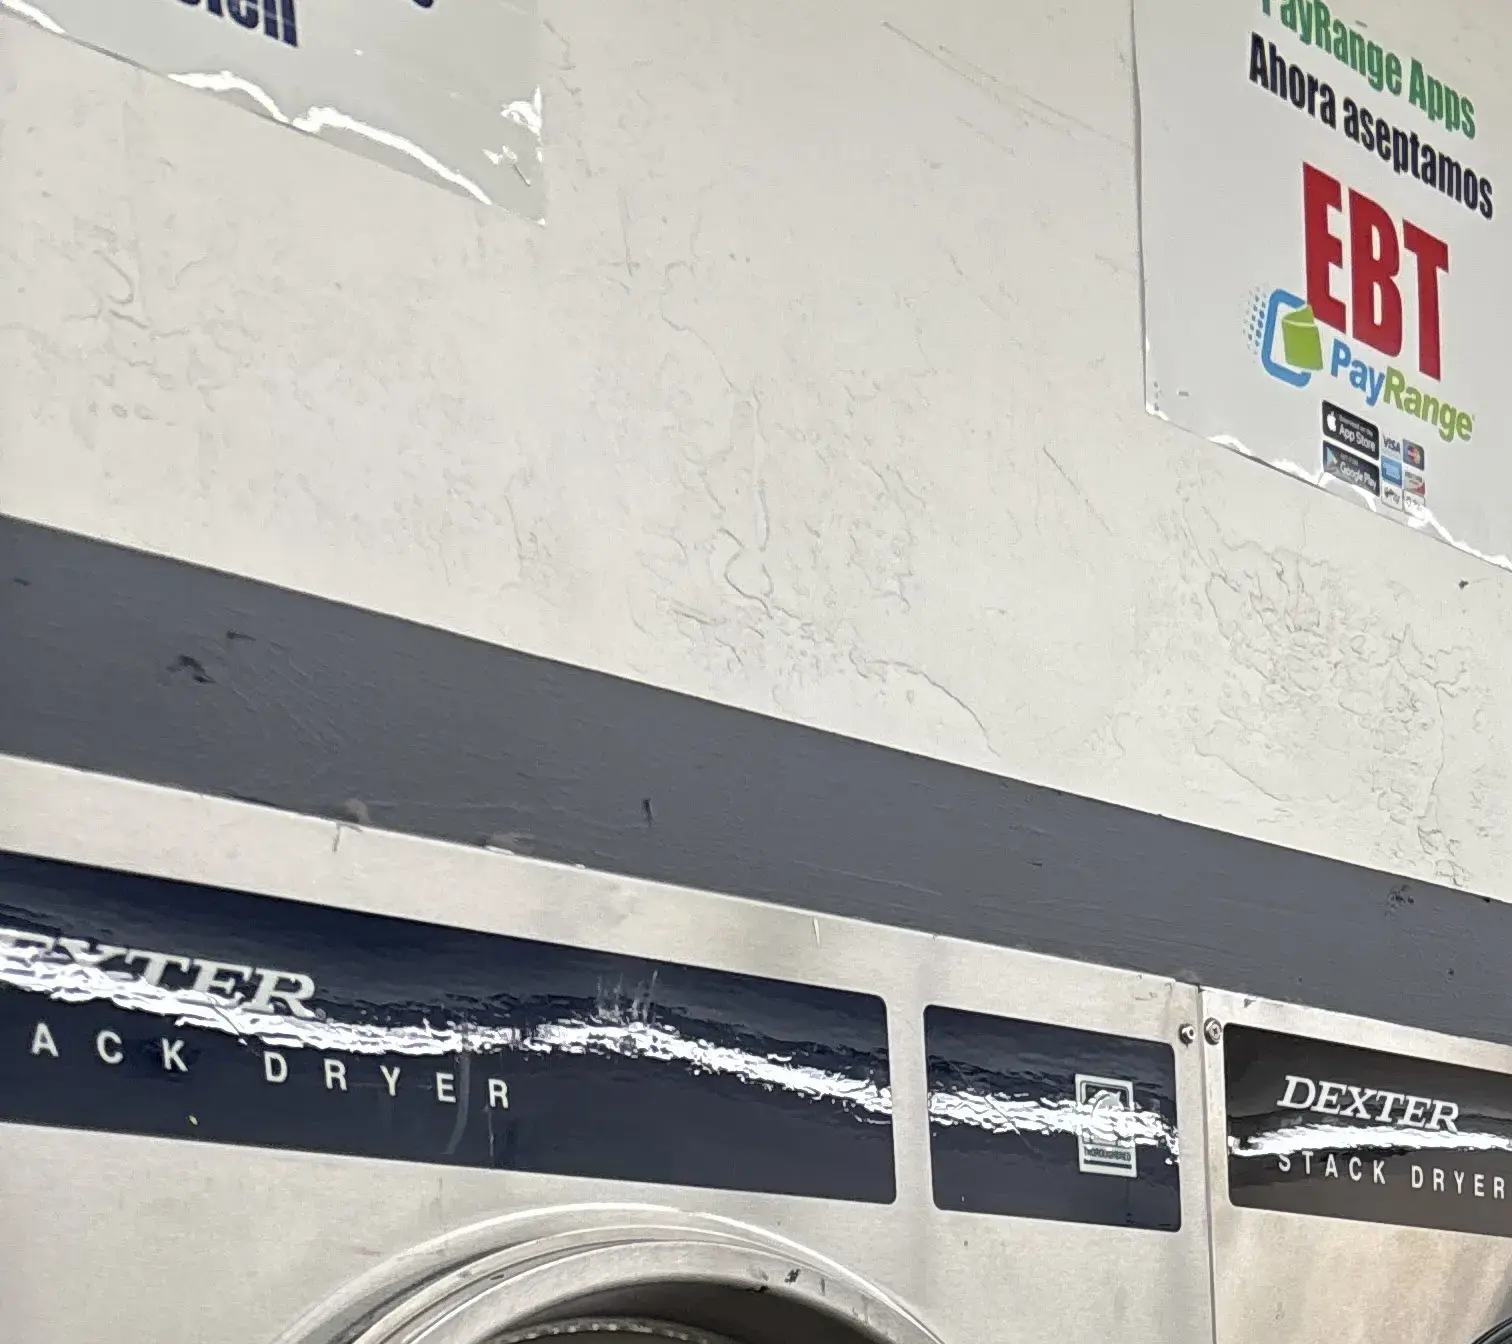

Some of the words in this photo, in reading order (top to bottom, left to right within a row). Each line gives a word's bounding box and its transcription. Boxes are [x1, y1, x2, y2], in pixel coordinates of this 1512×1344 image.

[1262, 0, 1402, 96] ayRange
[1408, 57, 1476, 140] Apps
[1249, 31, 1337, 129] Ahora
[1343, 95, 1493, 220] aseptamos
[1303, 161, 1449, 381] EBT
[1330, 338, 1474, 443] PayRange
[264, 1042, 511, 1111] DRYER
[1276, 1075, 1460, 1133] DEXTER
[1278, 1152, 1388, 1185] STACK
[1411, 1165, 1506, 1200] DRYER
